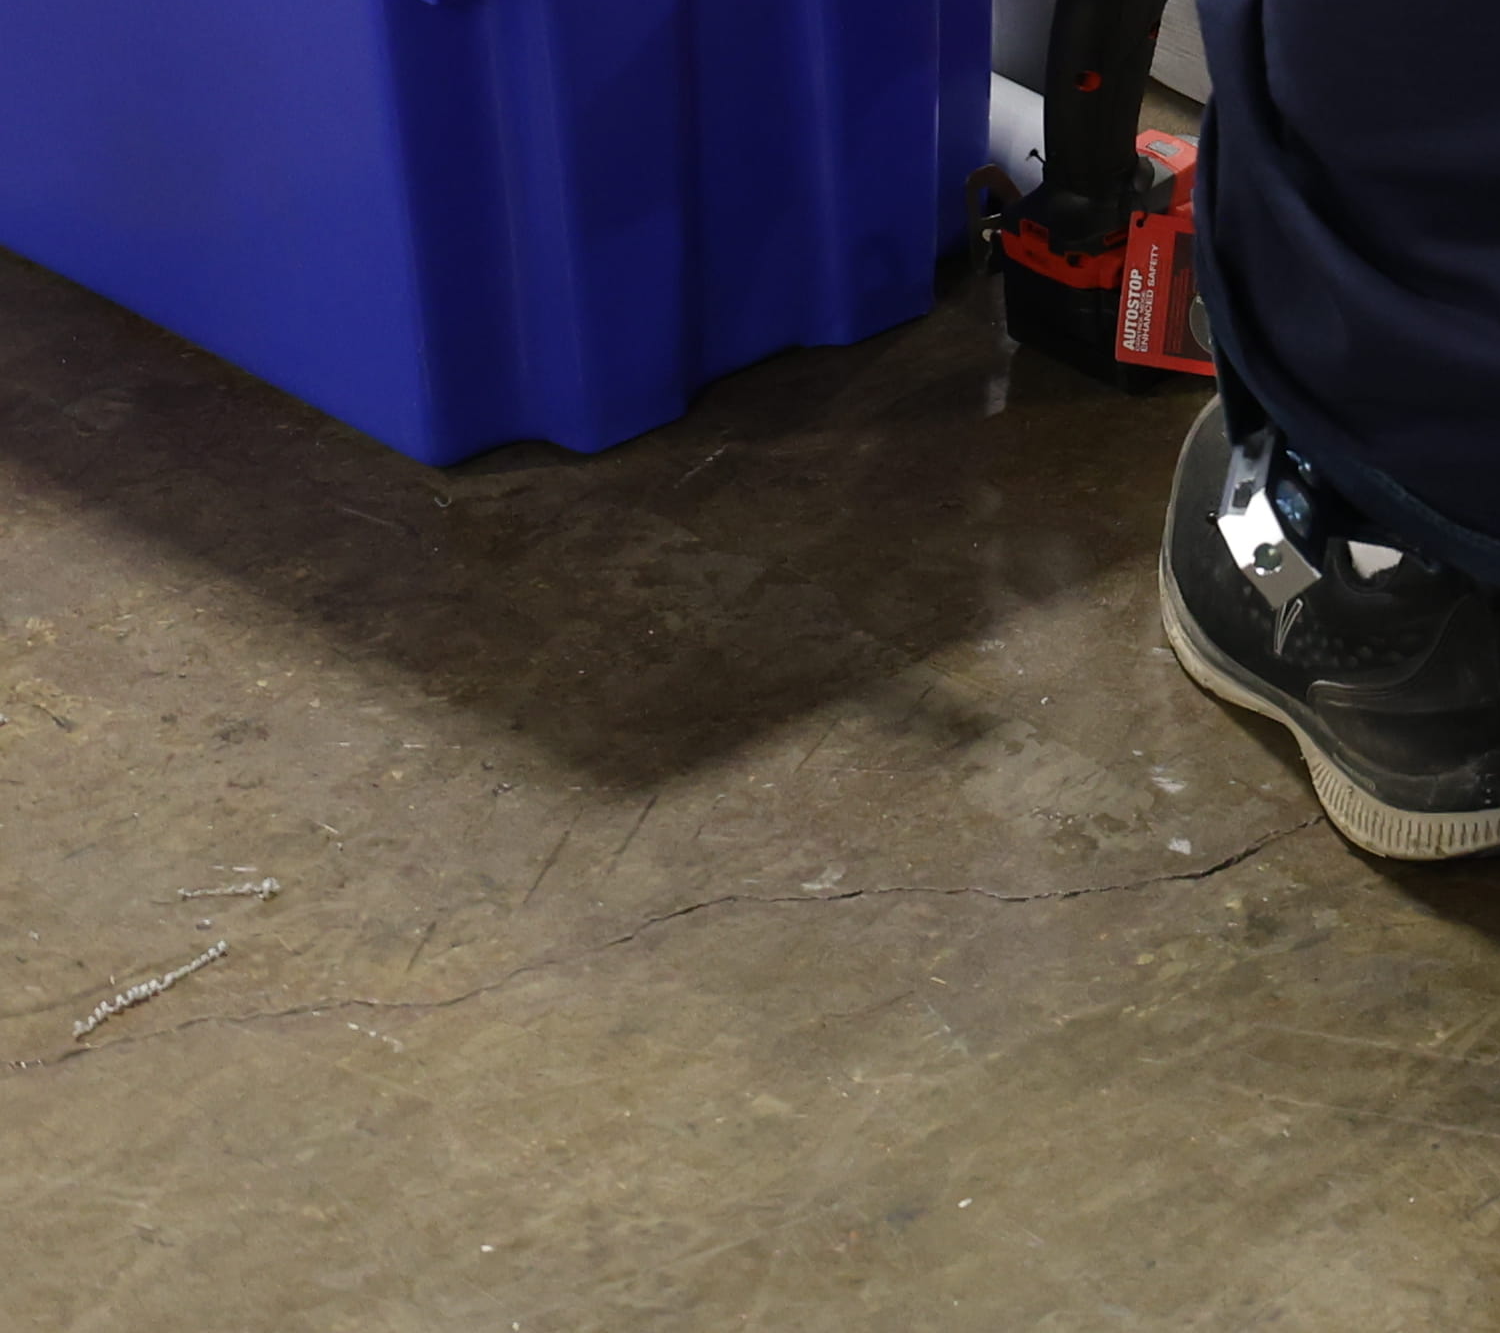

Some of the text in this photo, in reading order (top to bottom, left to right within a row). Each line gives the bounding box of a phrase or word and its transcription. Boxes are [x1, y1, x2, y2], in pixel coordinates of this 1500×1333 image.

[1122, 268, 1143, 351] AUTOSTOP
[1140, 244, 1160, 353] ENHANCED SAFETY
